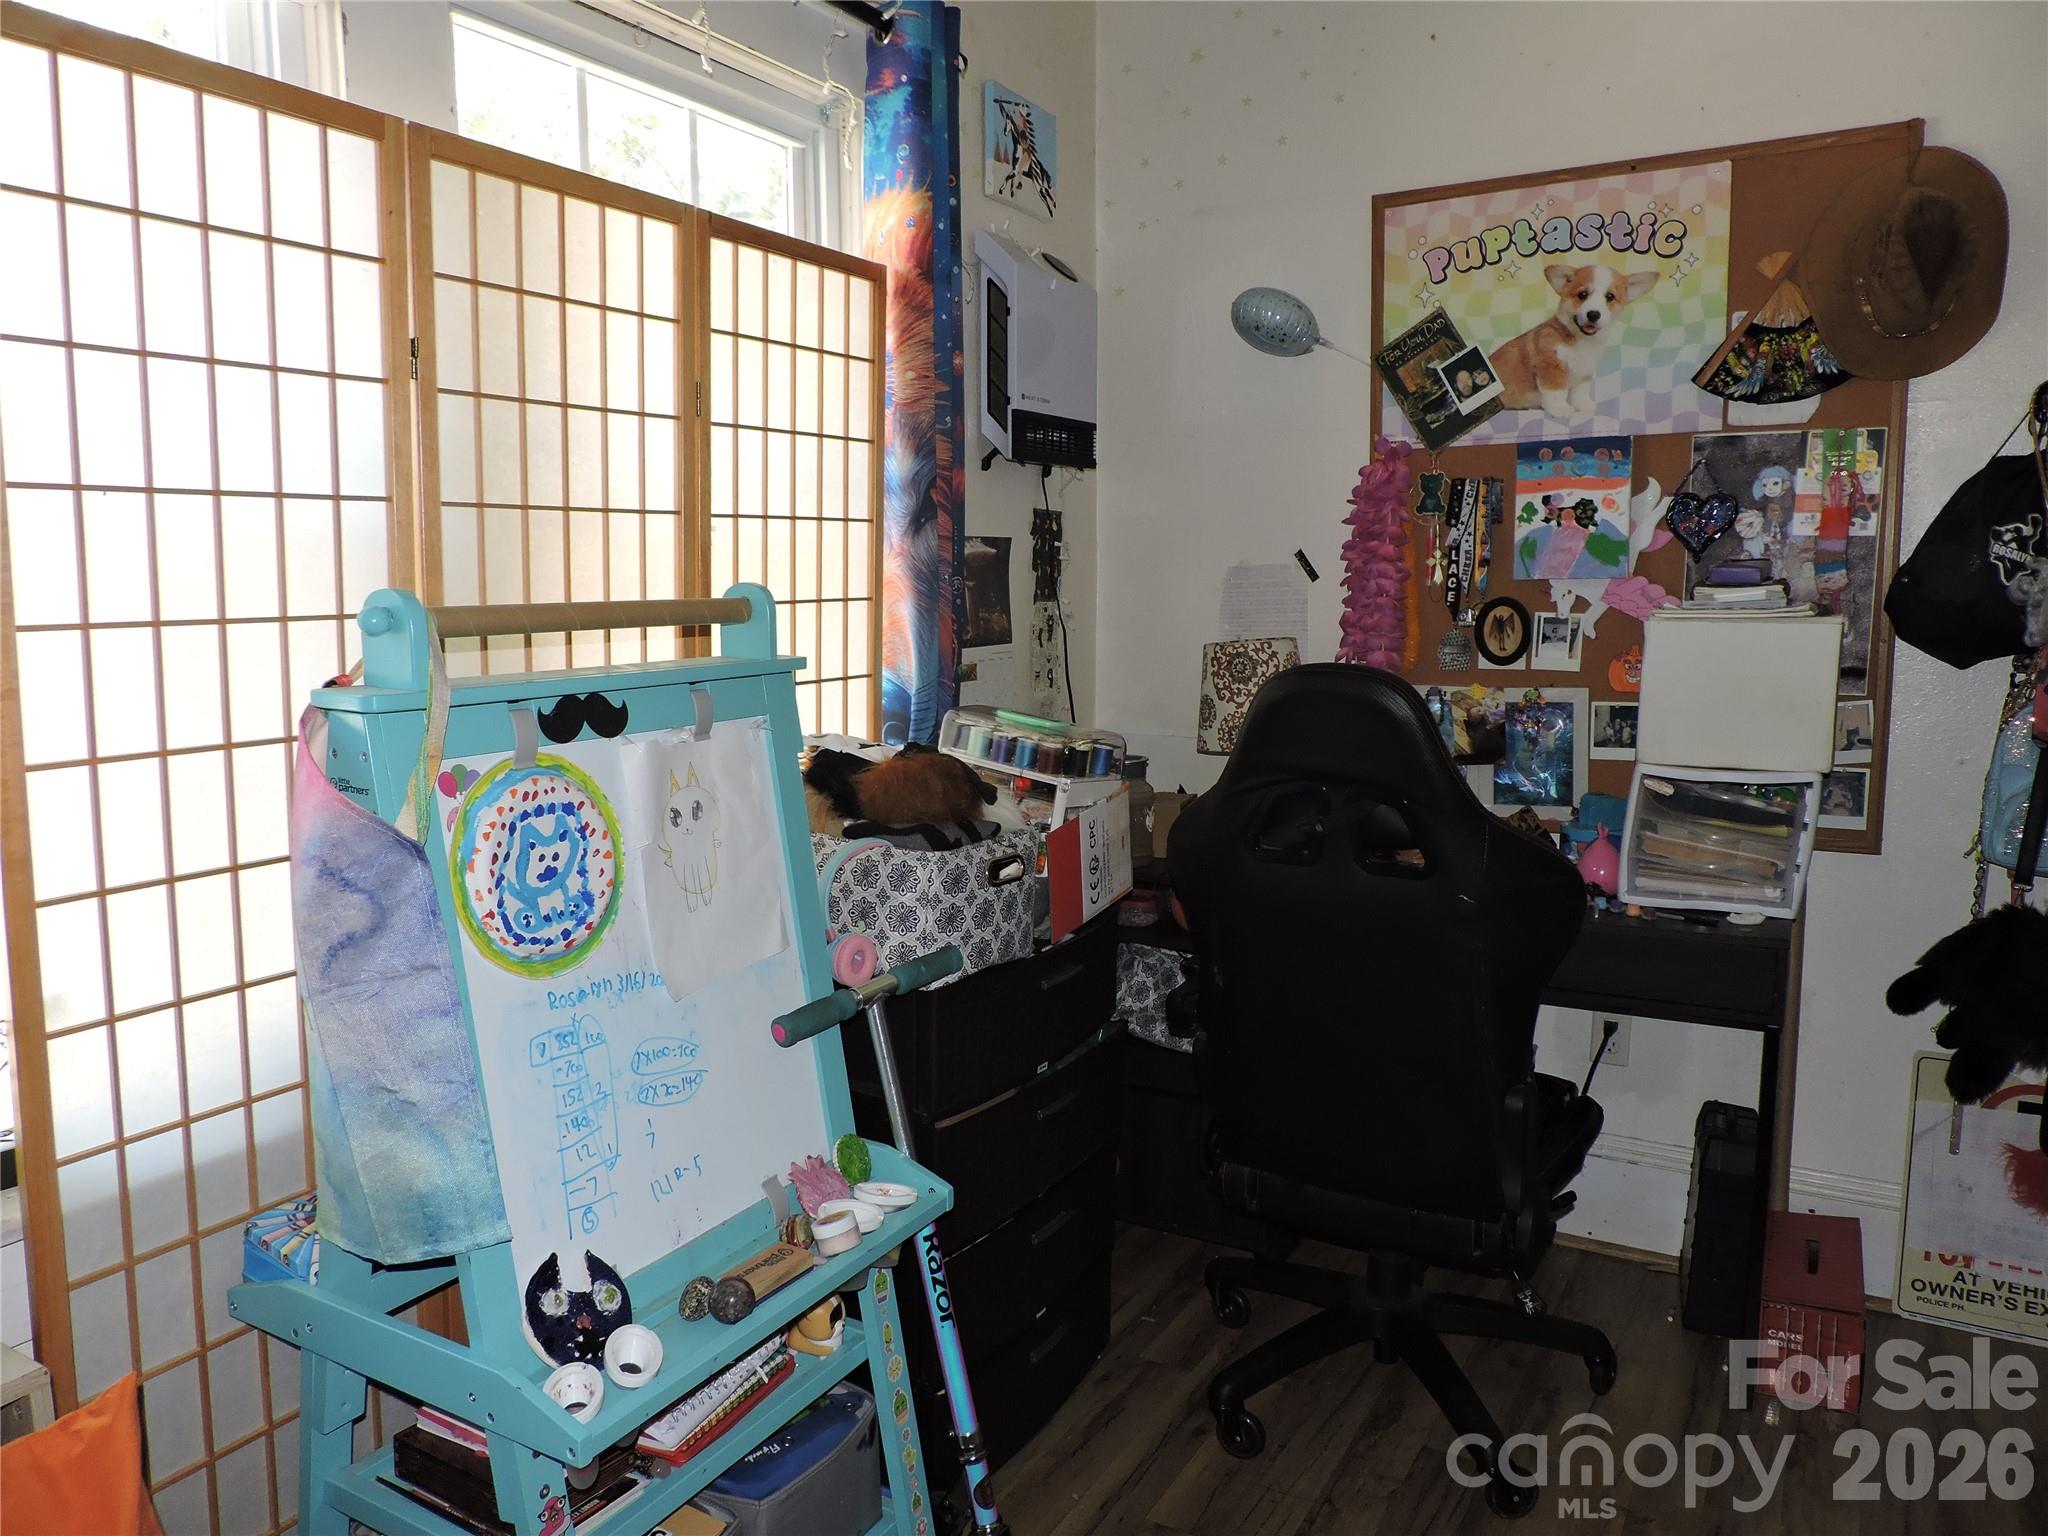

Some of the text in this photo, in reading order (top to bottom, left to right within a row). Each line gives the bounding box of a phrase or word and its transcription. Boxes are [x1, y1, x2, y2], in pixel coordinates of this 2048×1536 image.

[1423, 210, 1688, 285] puptastic
[338, 784, 370, 796] partners
[1088, 819, 1096, 849] CPC
[923, 1233, 955, 1329] Razor
[1910, 1278, 2019, 1311] OWNER'S
[1952, 1270, 2048, 1301] AT VEHI
[1916, 1295, 1950, 1308] POLICE
[1767, 1329, 1803, 1343] CARS
